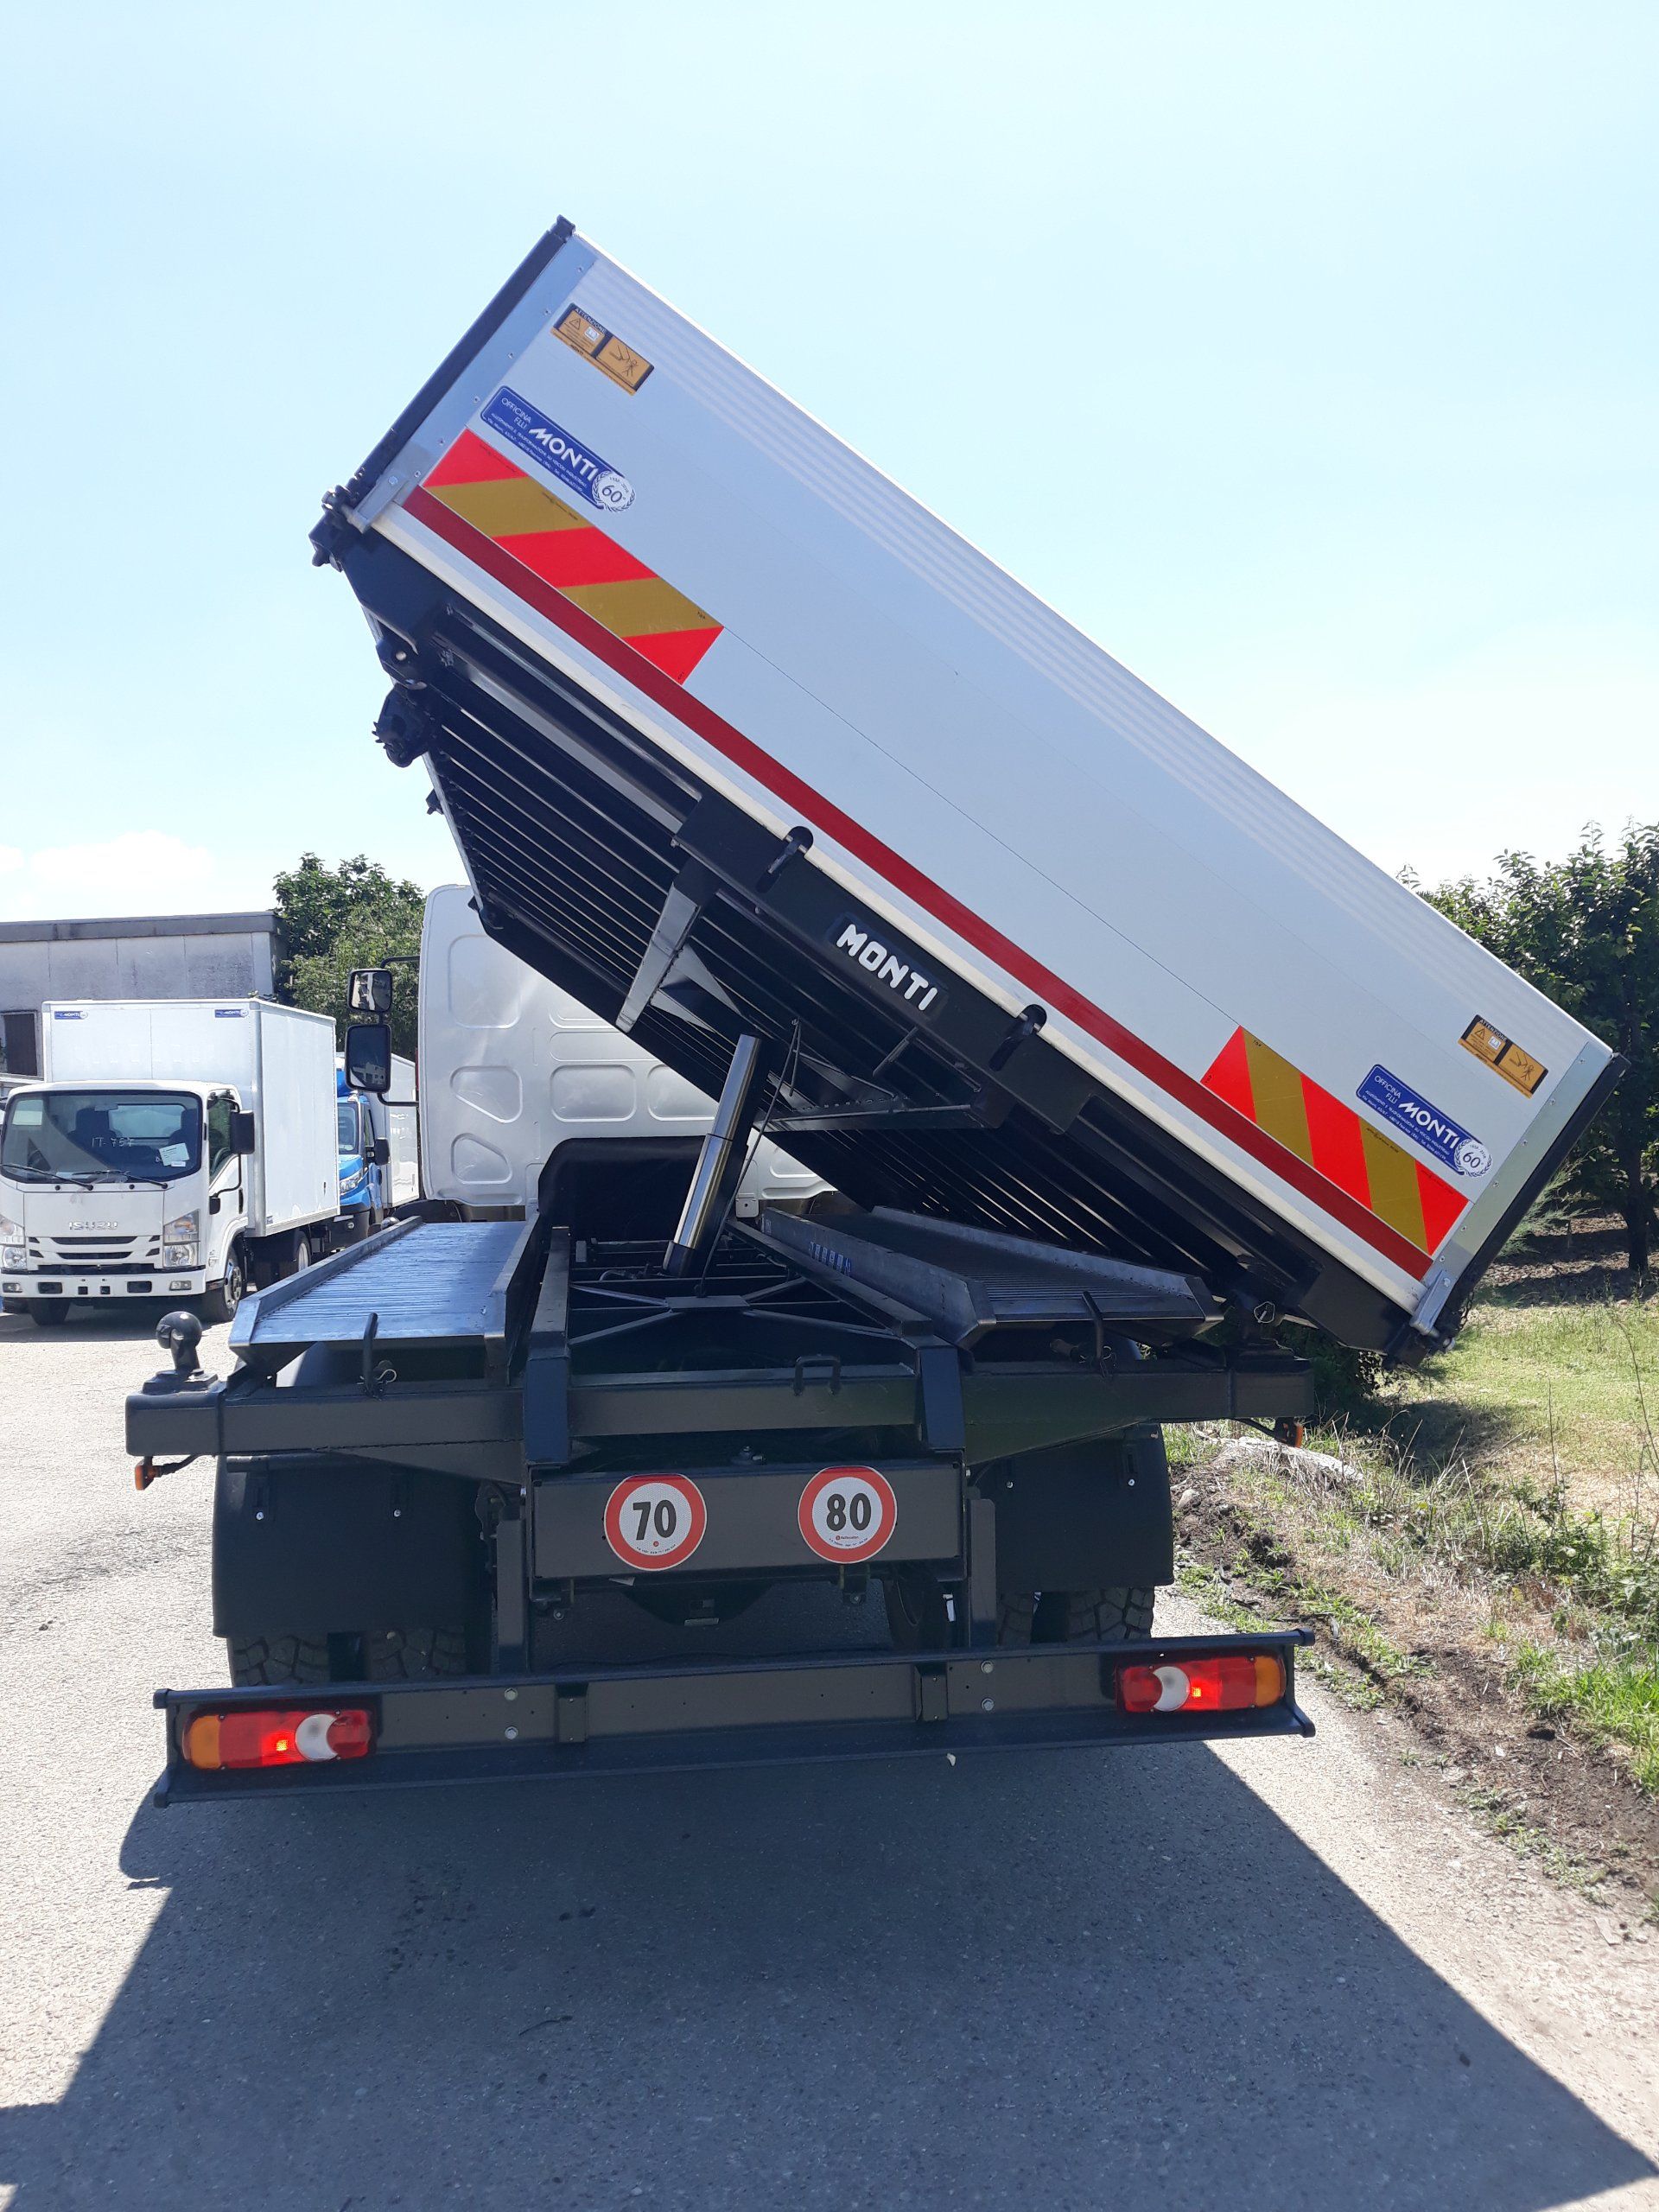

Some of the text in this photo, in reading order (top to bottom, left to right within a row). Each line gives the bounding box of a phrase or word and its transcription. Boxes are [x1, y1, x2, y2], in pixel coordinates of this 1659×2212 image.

[501, 397, 533, 423] OFFICINA
[529, 428, 599, 481] MONTI
[836, 923, 938, 1011] MONTI
[1374, 1075, 1402, 1098] OFFICINA
[1398, 1102, 1460, 1149] MONTI
[68, 1221, 118, 1230] ISUZU
[632, 1499, 677, 1541] 70
[826, 1492, 872, 1532] 80
